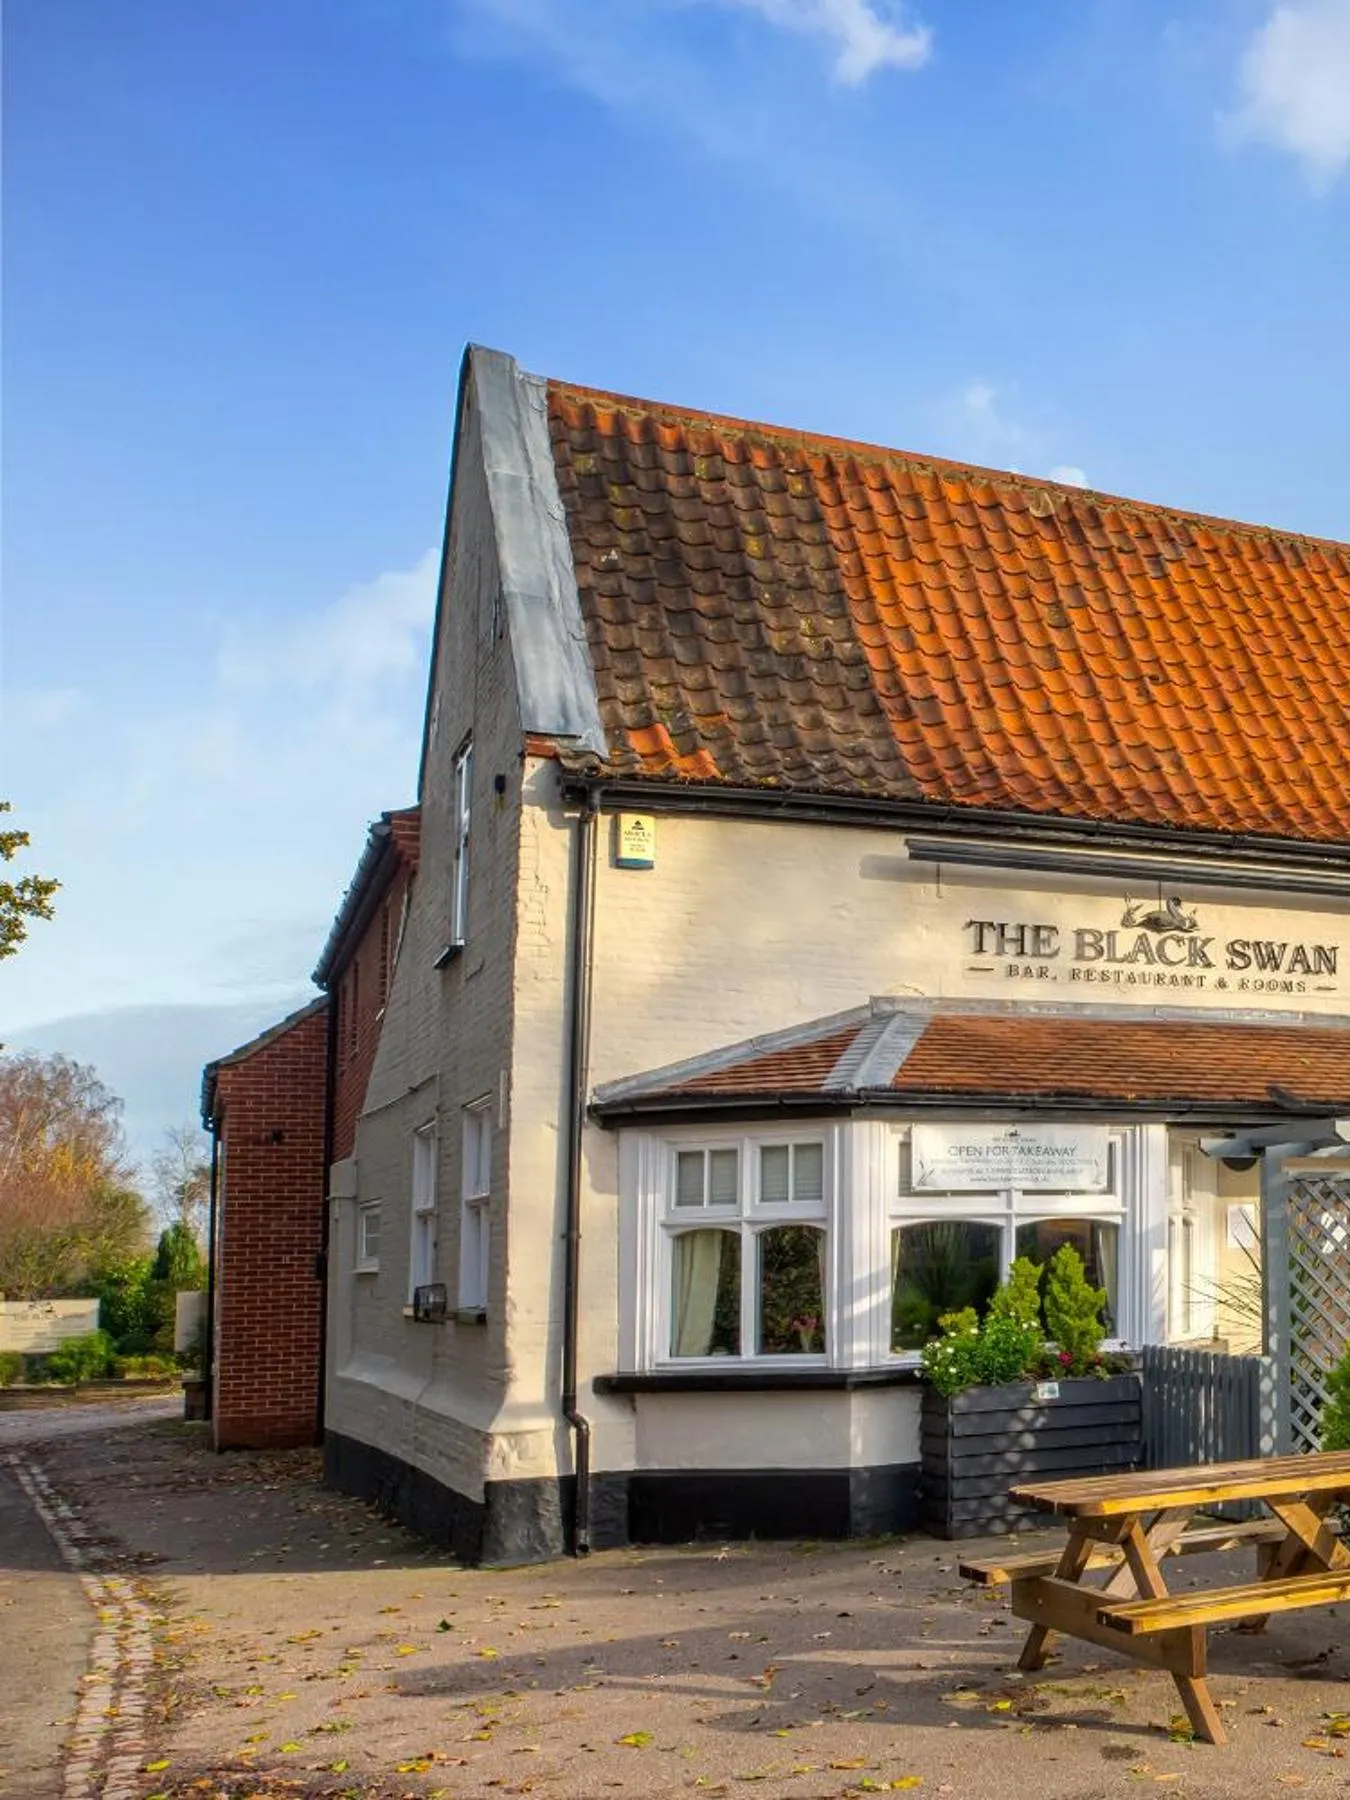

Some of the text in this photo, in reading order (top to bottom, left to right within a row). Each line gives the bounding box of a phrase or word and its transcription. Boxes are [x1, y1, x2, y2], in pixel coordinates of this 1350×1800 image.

[963, 919, 1340, 976] THE BLACK SWAN
[1071, 967, 1207, 989] RESTAURANT
[1215, 977, 1228, 989] &
[1239, 978, 1306, 993] ROOMS
[948, 1145, 1077, 1157] OPEN FOR TAKEAWAY
